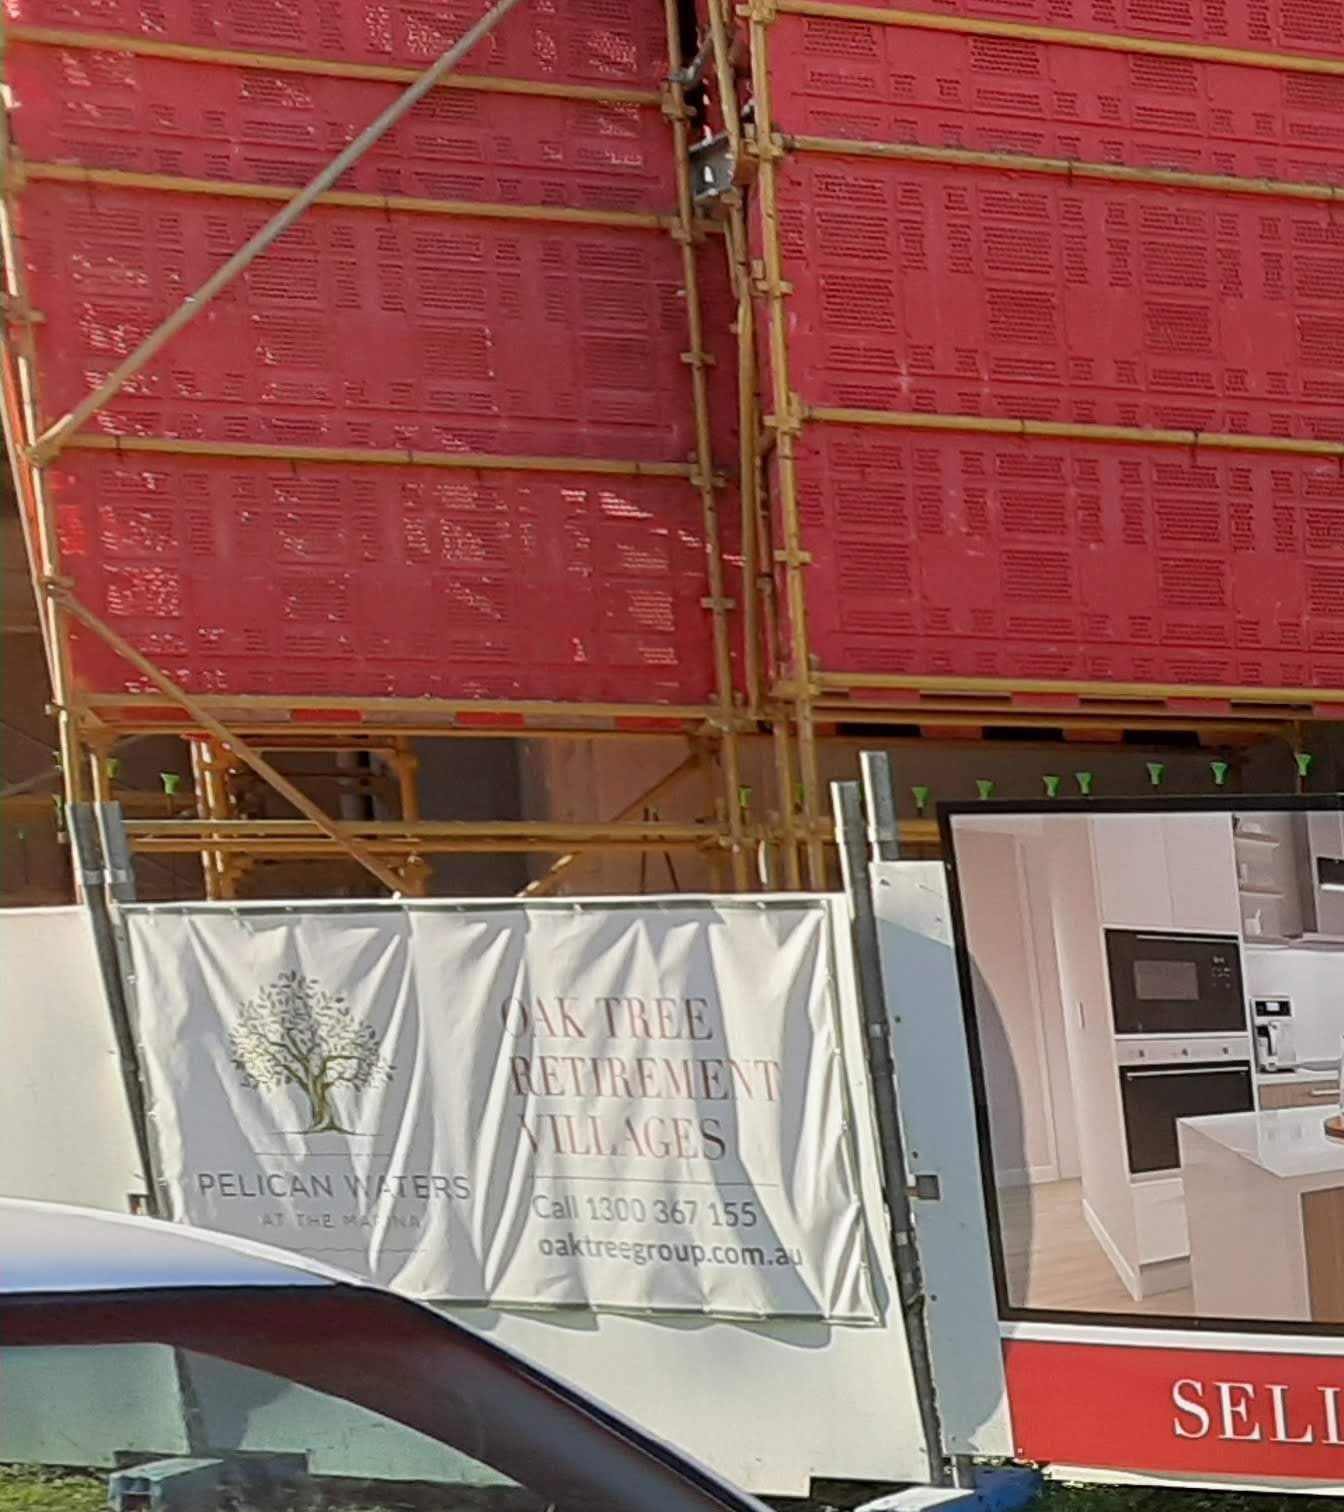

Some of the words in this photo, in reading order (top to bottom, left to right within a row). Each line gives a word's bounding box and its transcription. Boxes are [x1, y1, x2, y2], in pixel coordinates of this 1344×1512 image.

[501, 996, 586, 1039] OAK
[595, 997, 714, 1041] TREE
[510, 1055, 783, 1102] RETIREMENT
[520, 1113, 727, 1162] VILLAGES
[197, 1173, 335, 1198] PELICAN
[344, 1174, 471, 1200] WATERS
[532, 1195, 578, 1220] Call
[586, 1197, 646, 1222] 1300
[654, 1200, 698, 1224] 367
[711, 1201, 758, 1227] 155
[537, 1232, 804, 1267] oaktreegroup.com.au
